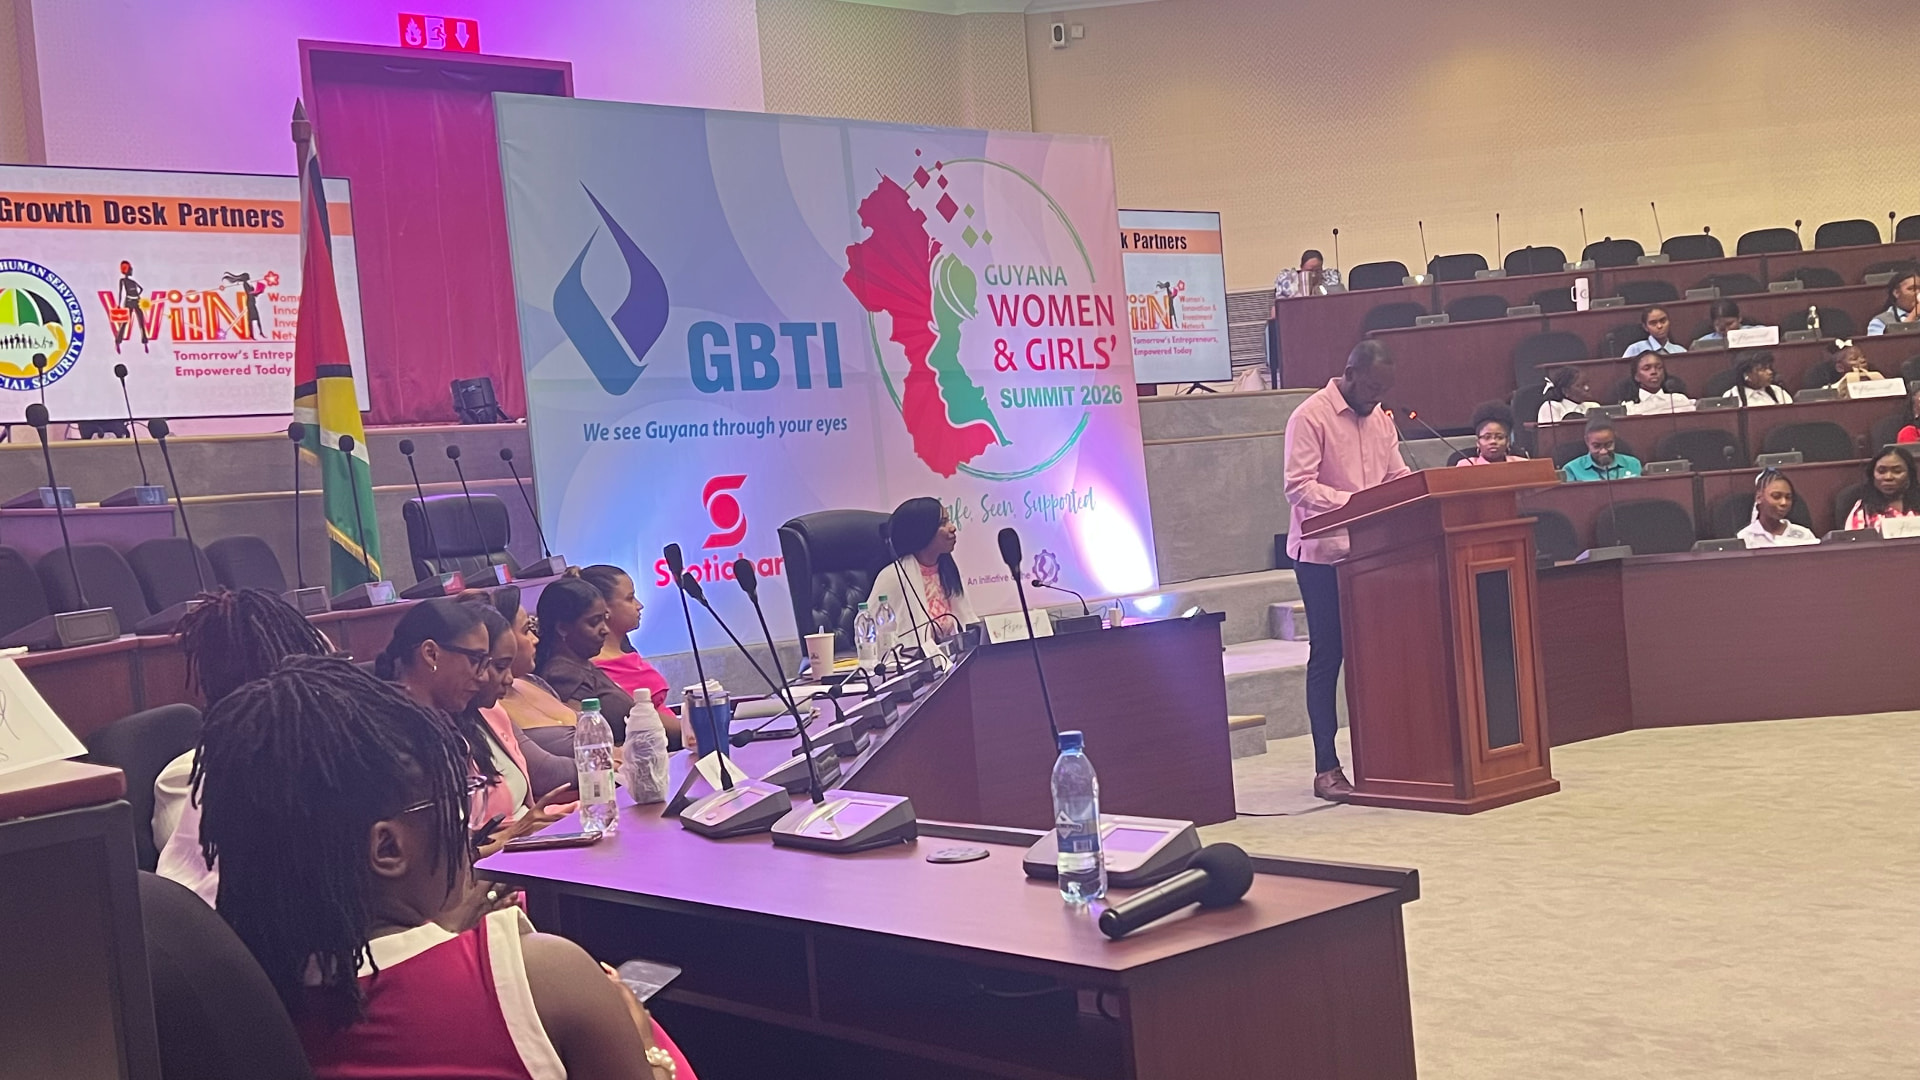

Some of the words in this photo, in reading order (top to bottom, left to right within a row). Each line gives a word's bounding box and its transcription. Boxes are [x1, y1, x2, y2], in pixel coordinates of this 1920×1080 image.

[0, 197, 92, 224] Growth
[104, 200, 168, 226] Desk
[178, 202, 285, 229] Partners
[1134, 233, 1187, 250] Partners
[984, 264, 1068, 287] GUYANA
[0, 260, 47, 278] HUMAN
[45, 272, 83, 324] SERVICES
[987, 293, 1116, 328] WOMEN
[173, 349, 249, 361] Tomorrow's
[687, 320, 844, 394] GBTI
[993, 338, 1018, 373] &
[1025, 334, 1118, 372] GIRLS'
[175, 364, 252, 379] Empowered
[255, 363, 292, 377] Today
[1000, 386, 1075, 409] SUMMIT
[1081, 385, 1123, 406] 2026
[583, 422, 610, 442] We
[613, 427, 641, 440] see
[645, 420, 709, 444] Guyana
[712, 416, 776, 439] through
[778, 418, 813, 439] your
[816, 417, 848, 436] eyes
[938, 497, 974, 531] afe,
[1023, 486, 1096, 523] Supported
